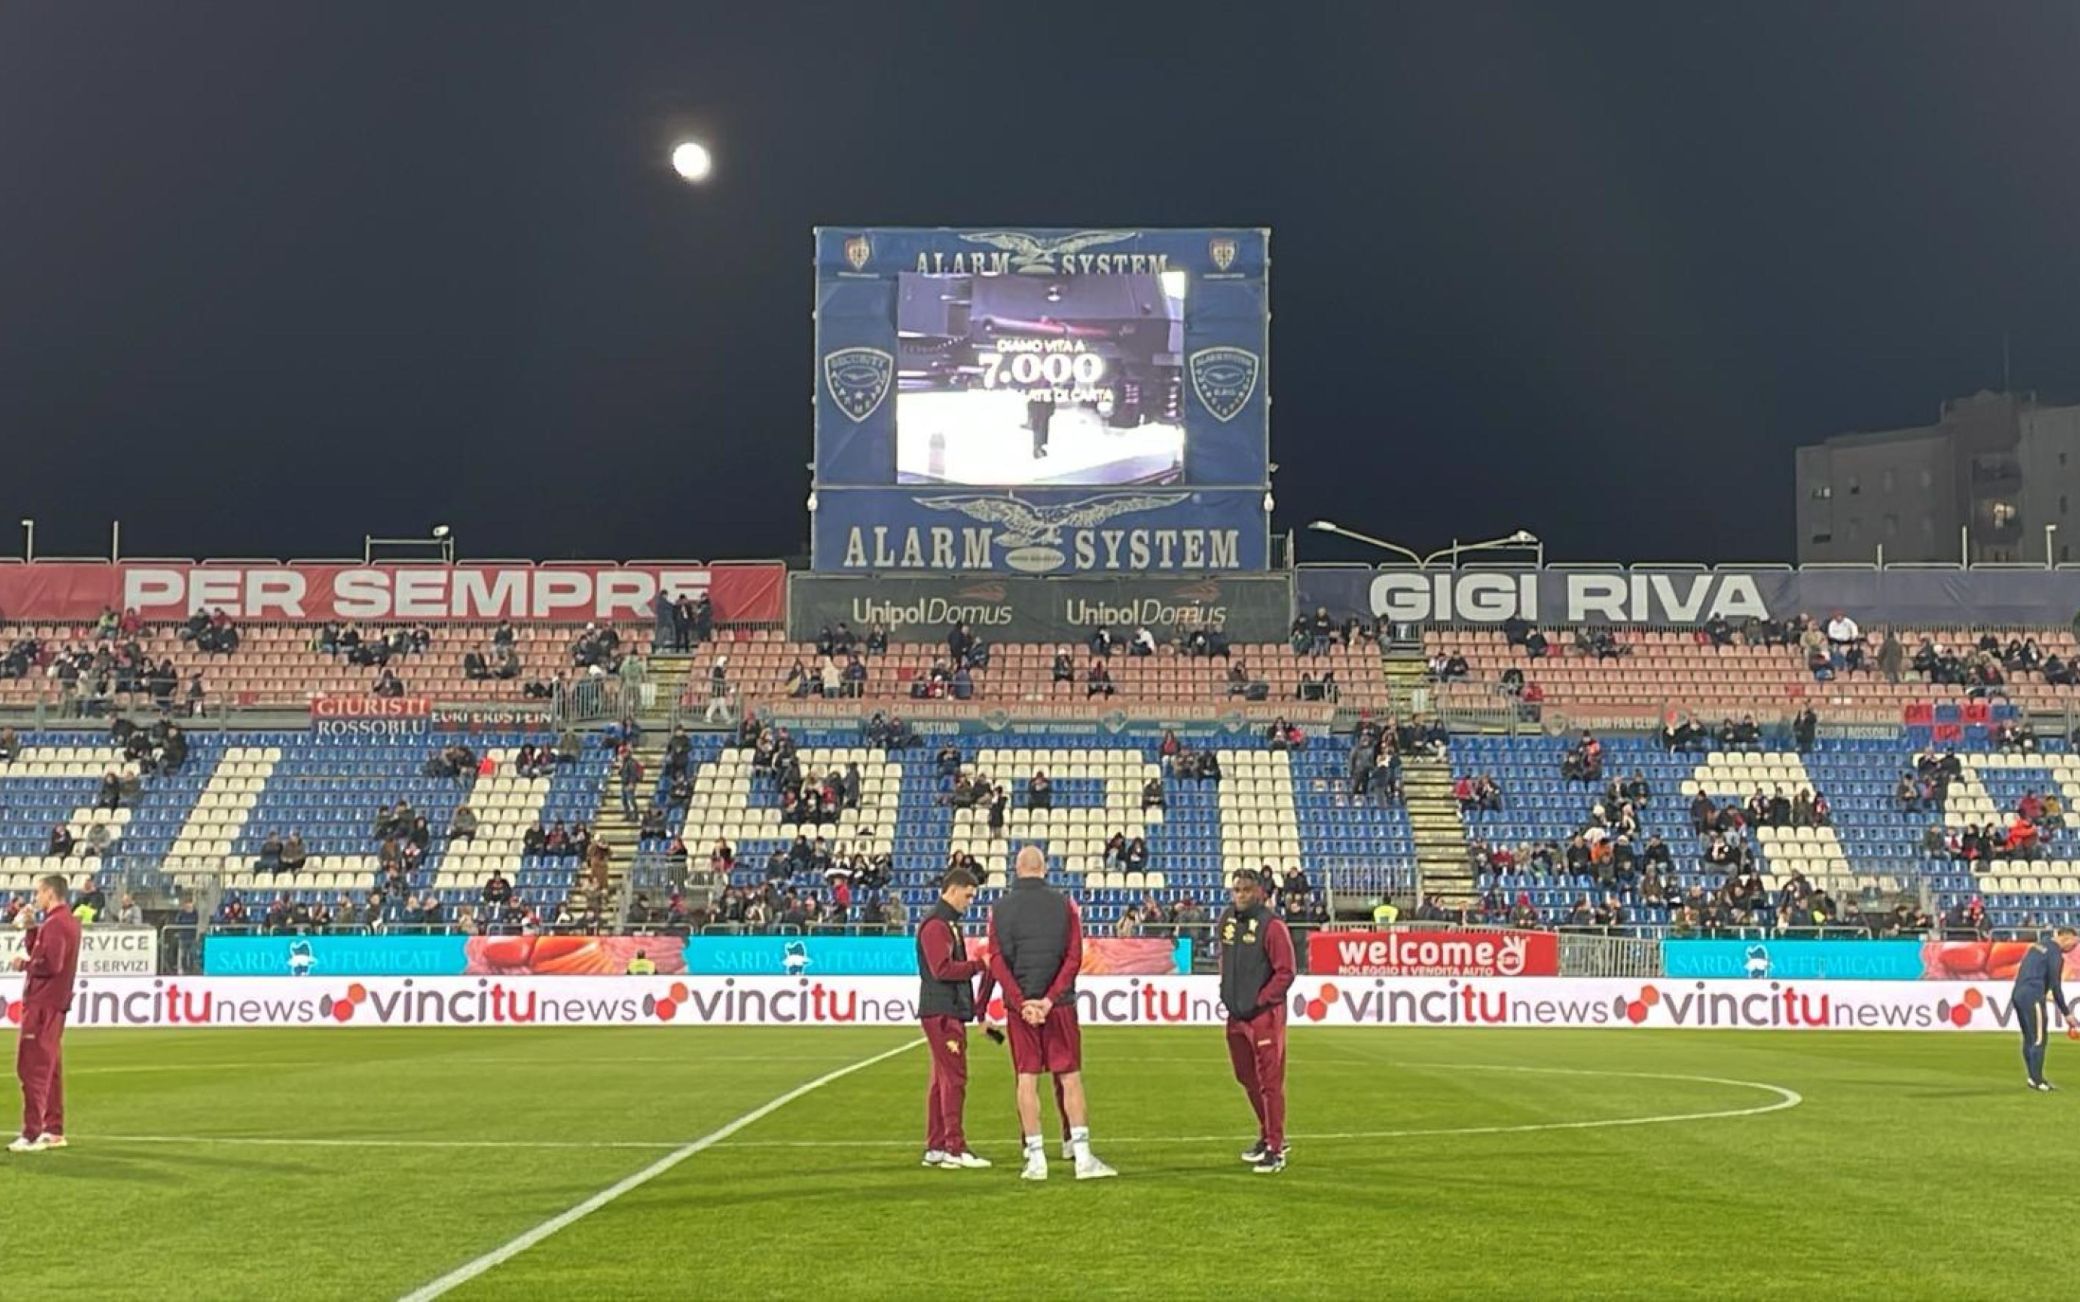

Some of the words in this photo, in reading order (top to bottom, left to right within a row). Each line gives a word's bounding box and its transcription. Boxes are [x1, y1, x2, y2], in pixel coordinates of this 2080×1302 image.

[917, 252, 1010, 274] ALARM
[1062, 253, 1168, 275] SYSTEM
[997, 340, 1042, 352] DIAMO
[1044, 340, 1073, 352] VITA
[1074, 340, 1086, 352] A
[978, 353, 1104, 389] 7.000
[844, 526, 993, 568] ALARM
[1074, 528, 1240, 570] SYSTEM
[123, 568, 303, 619] PER
[1369, 573, 1539, 623] GIGI
[1568, 573, 1771, 623] RIVA
[317, 699, 428, 716] GIURISTI
[317, 719, 428, 736] ROSSOBLU
[218, 951, 287, 971] SARDA
[316, 951, 443, 971] AFFUMICATI
[714, 951, 782, 970] SARDA
[1338, 933, 1495, 966] welcome
[80, 960, 89, 972] E
[94, 960, 148, 973] SERVIZI
[1338, 965, 1399, 976] NOLEGGIO
[1401, 965, 1408, 976] E
[1411, 965, 1459, 976] VENDITA
[1462, 965, 1495, 976] AUTO
[1675, 953, 1744, 974] SARDA
[1773, 953, 1898, 975] AFFUMICATI
[70, 979, 315, 1023] incitunews
[370, 979, 637, 1022] vincitunews
[1342, 979, 1609, 1023] vincitunews
[1663, 981, 1932, 1027] vincitunews
